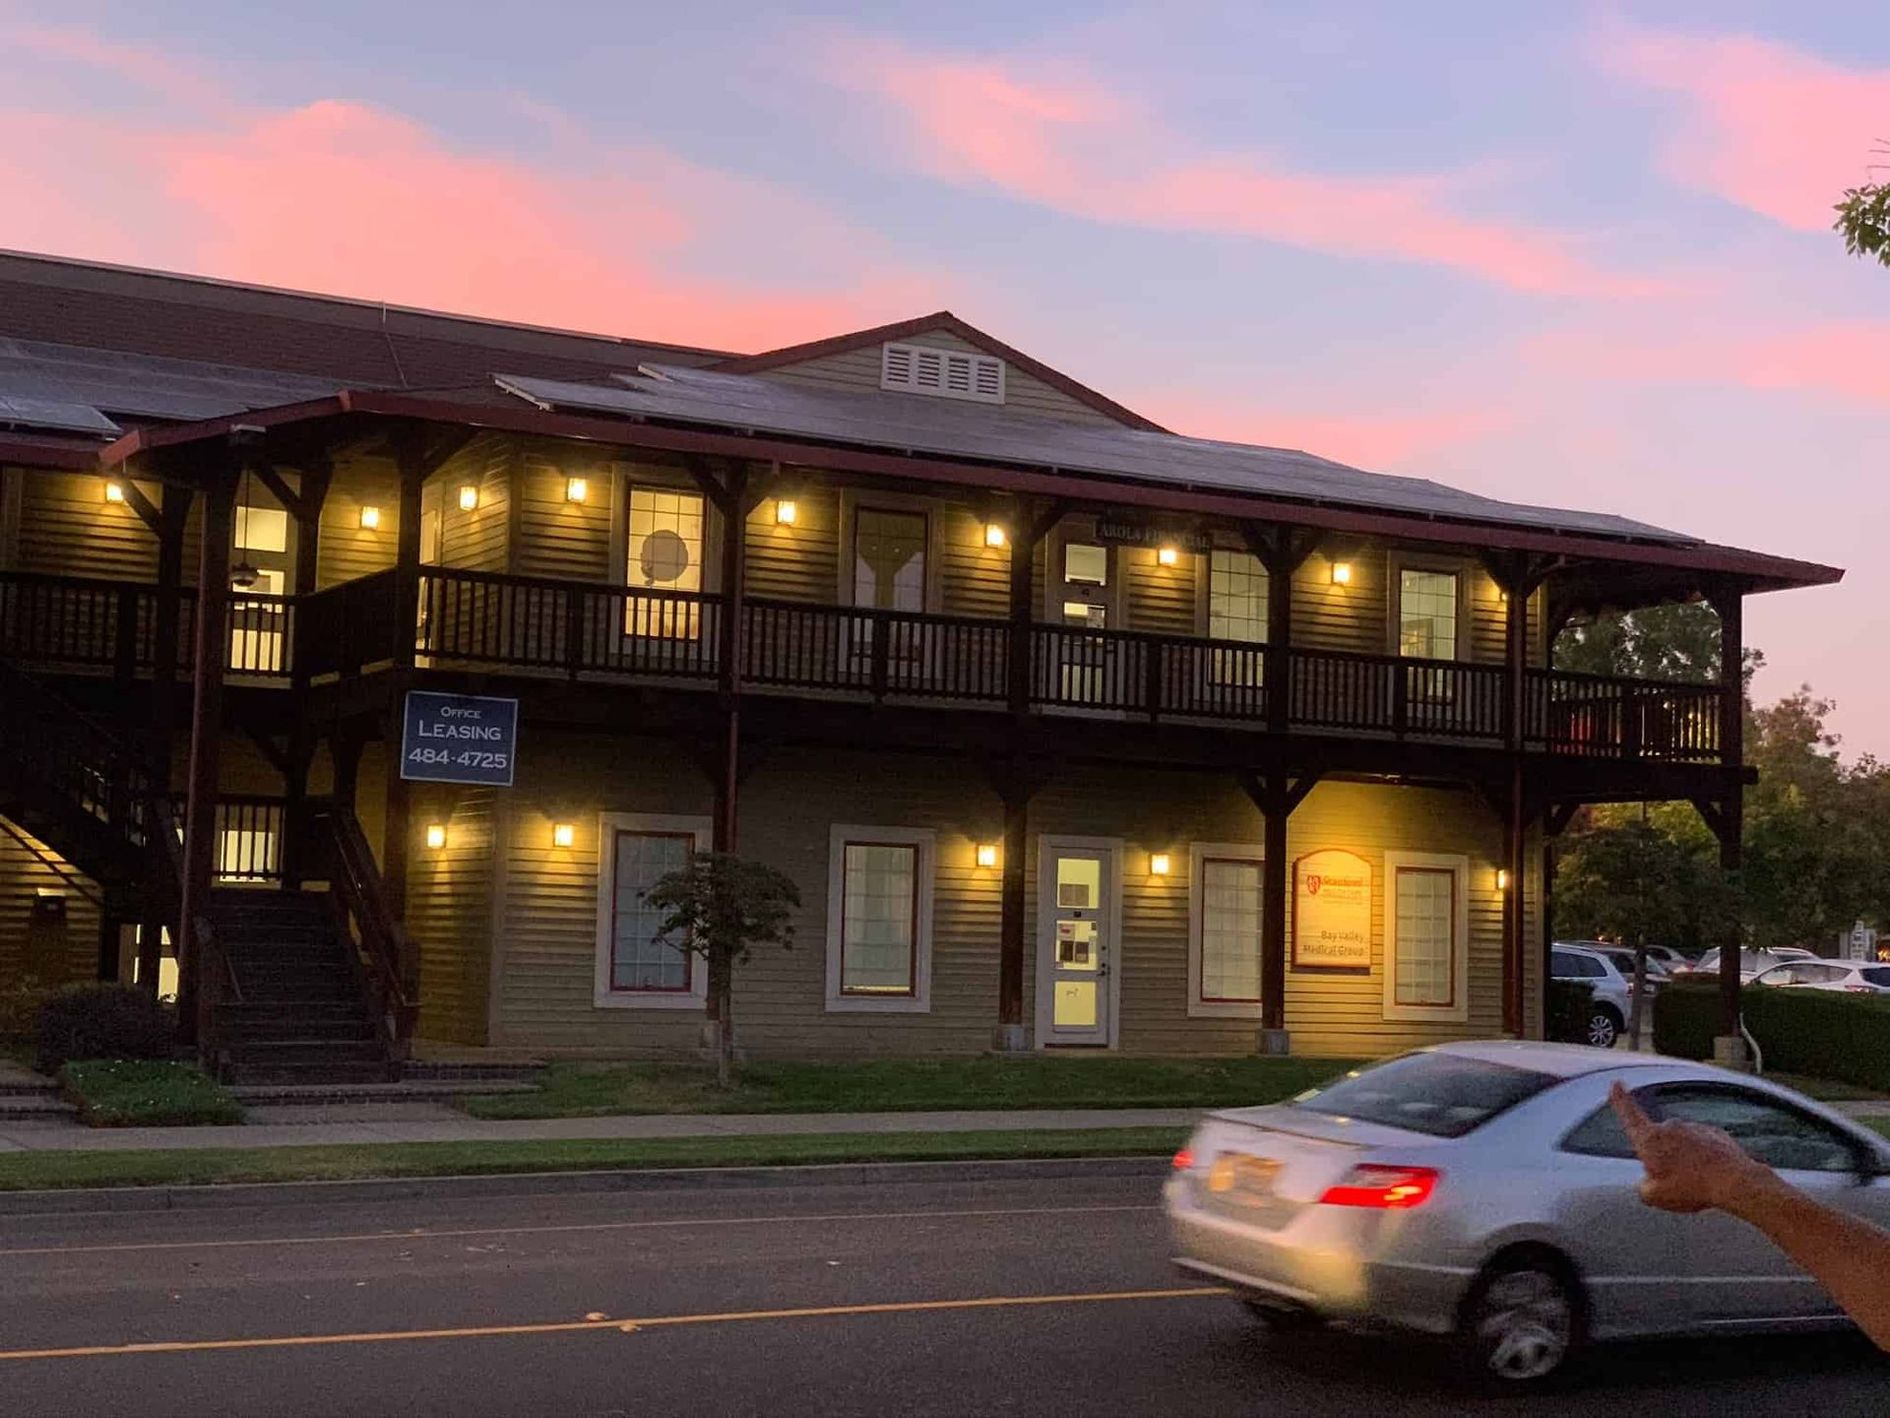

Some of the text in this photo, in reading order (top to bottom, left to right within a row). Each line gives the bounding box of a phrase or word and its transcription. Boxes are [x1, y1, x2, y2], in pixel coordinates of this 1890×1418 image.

[440, 706, 482, 719] OFFICE
[418, 719, 502, 741] LEASING
[408, 747, 508, 769] 484-4725
